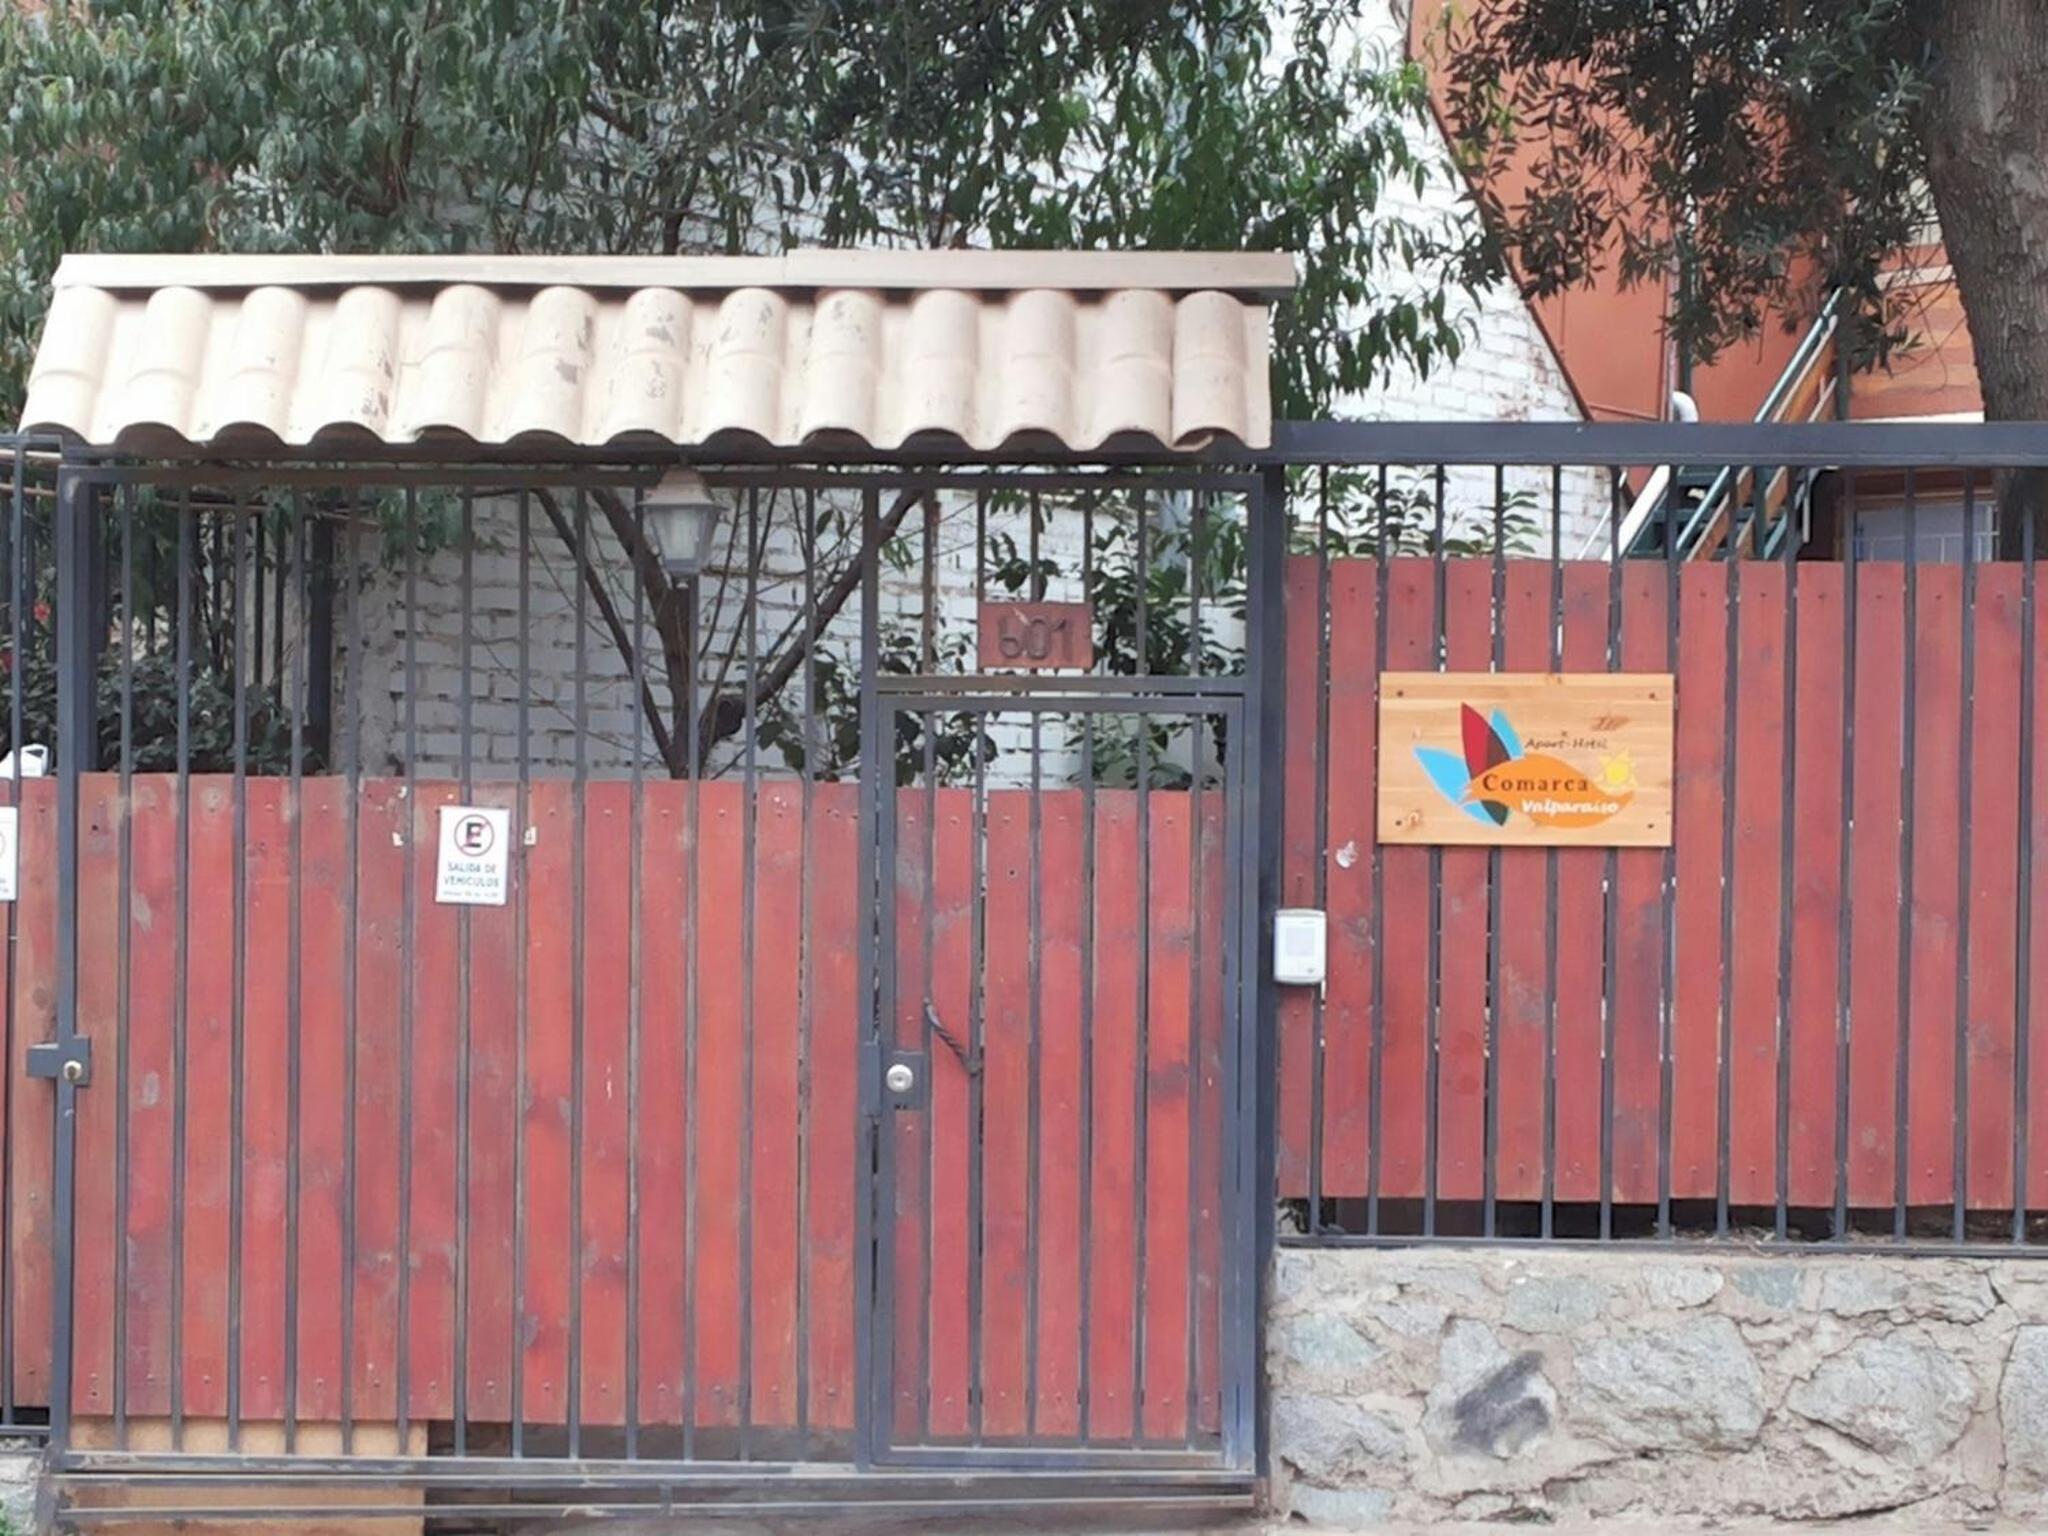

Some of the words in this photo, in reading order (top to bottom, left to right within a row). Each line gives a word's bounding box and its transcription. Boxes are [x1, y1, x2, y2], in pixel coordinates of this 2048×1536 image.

[998, 613, 1073, 661] 601
[1482, 773, 1588, 792] Comarca
[463, 822, 483, 848] E
[448, 862, 481, 873] SALIDA
[485, 864, 497, 874] DE
[444, 875, 499, 888] VEHICULOS
